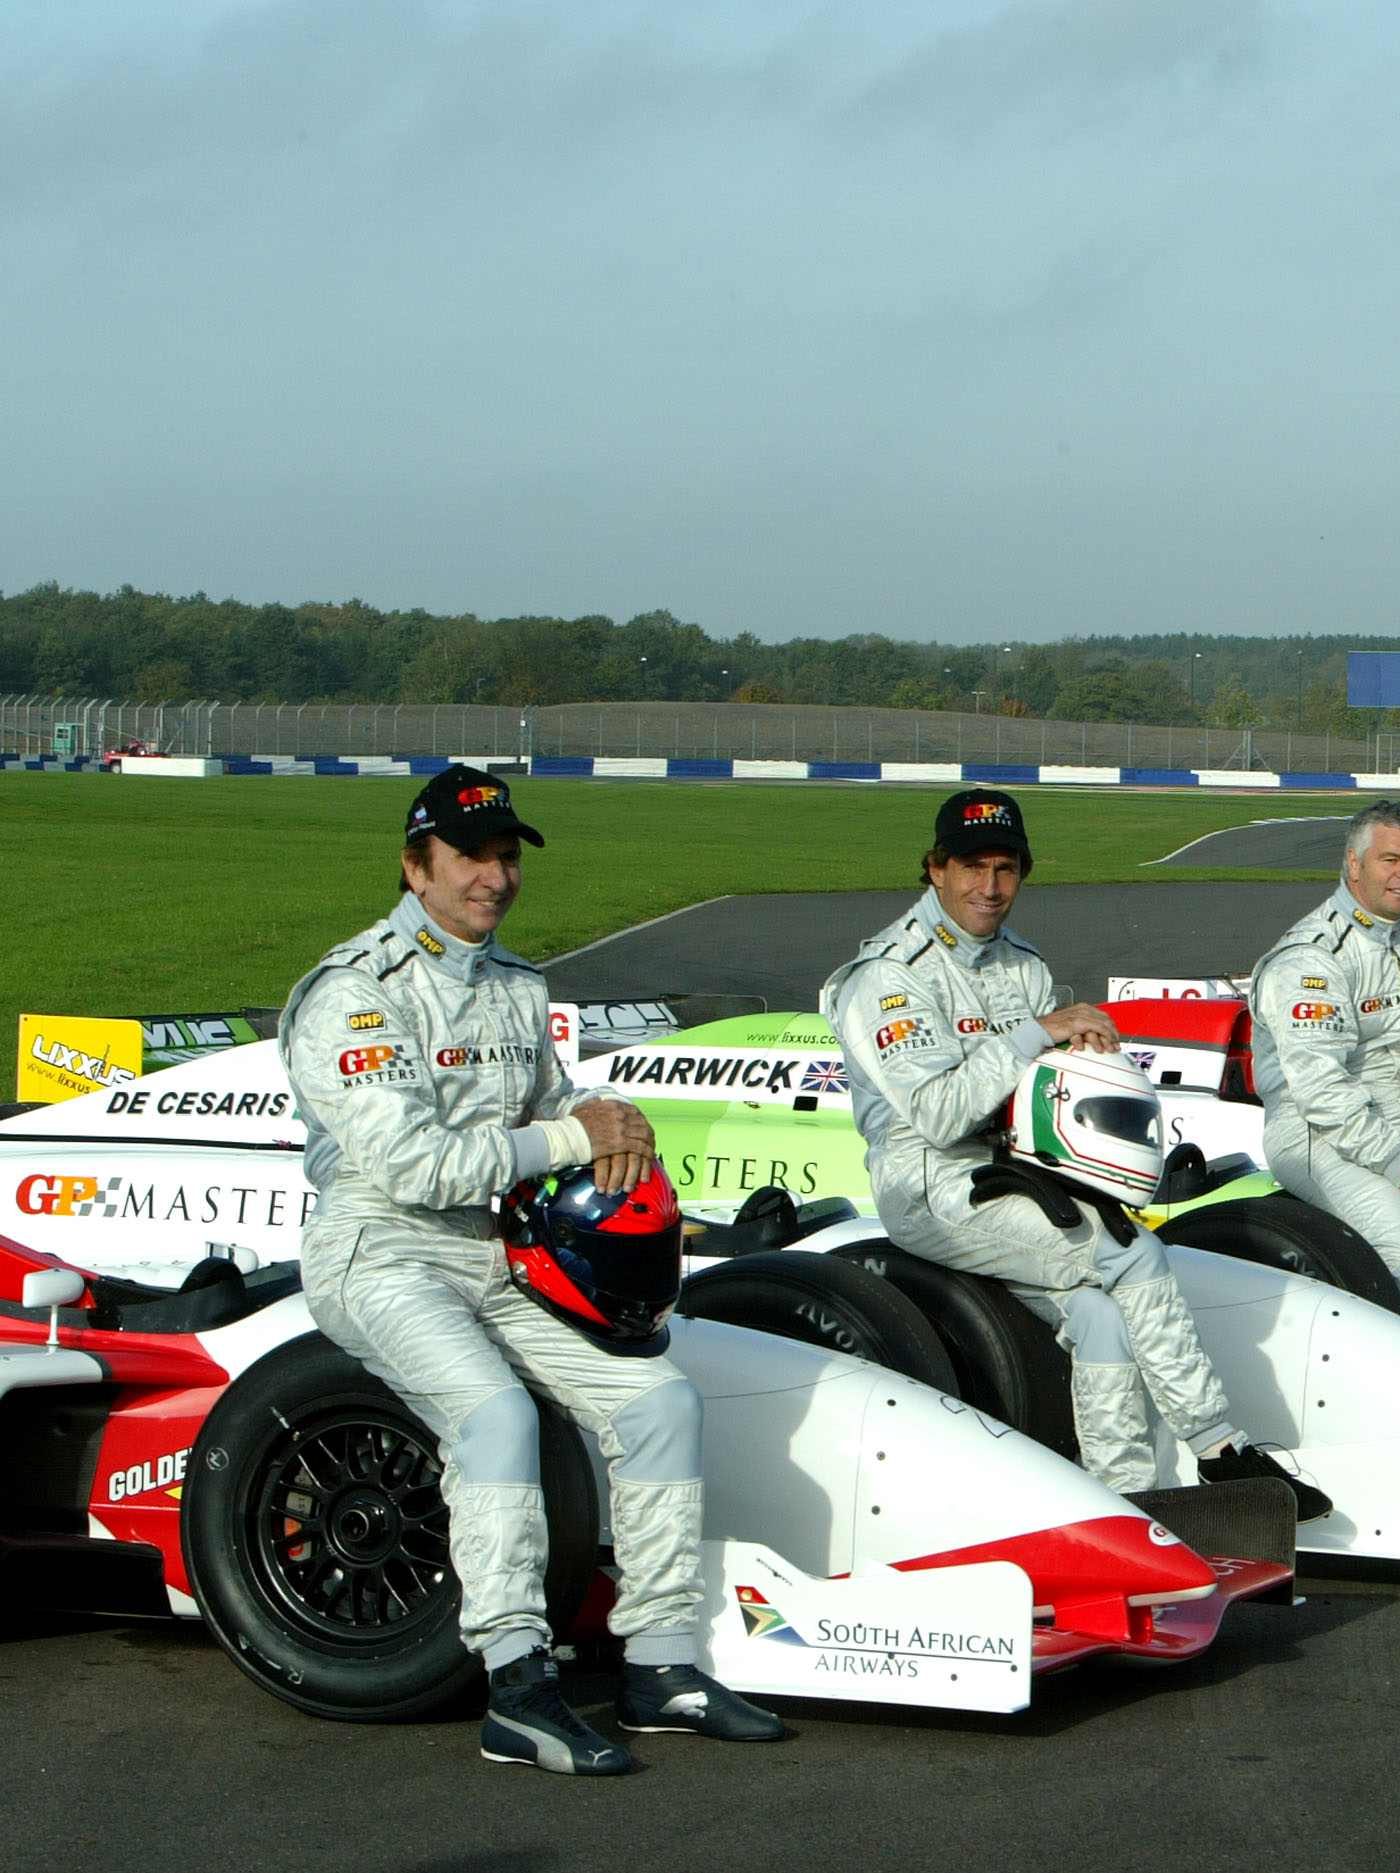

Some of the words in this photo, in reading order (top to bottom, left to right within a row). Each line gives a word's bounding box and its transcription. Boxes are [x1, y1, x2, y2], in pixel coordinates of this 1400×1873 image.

[417, 929, 445, 955] OMP
[1303, 977, 1326, 990] OMP
[880, 993, 906, 1011] OMP
[1292, 1002, 1334, 1020] GP
[350, 1012, 384, 1031] OMP
[876, 1018, 916, 1050] GP
[31, 1034, 136, 1087] LIXXUS
[340, 1044, 394, 1076] GP
[881, 1037, 937, 1062] MASTERS
[343, 1067, 418, 1090] MASTERS
[608, 1055, 799, 1090] WARWICK
[106, 1091, 151, 1115] DE
[157, 1091, 291, 1117] CESARIS
[15, 1173, 99, 1217] GP
[108, 1447, 193, 1502] GOLDE
[816, 1618, 900, 1648] SOUTH
[907, 1626, 1015, 1656] AFRICAN
[814, 1653, 919, 1679] AIRWAYS
